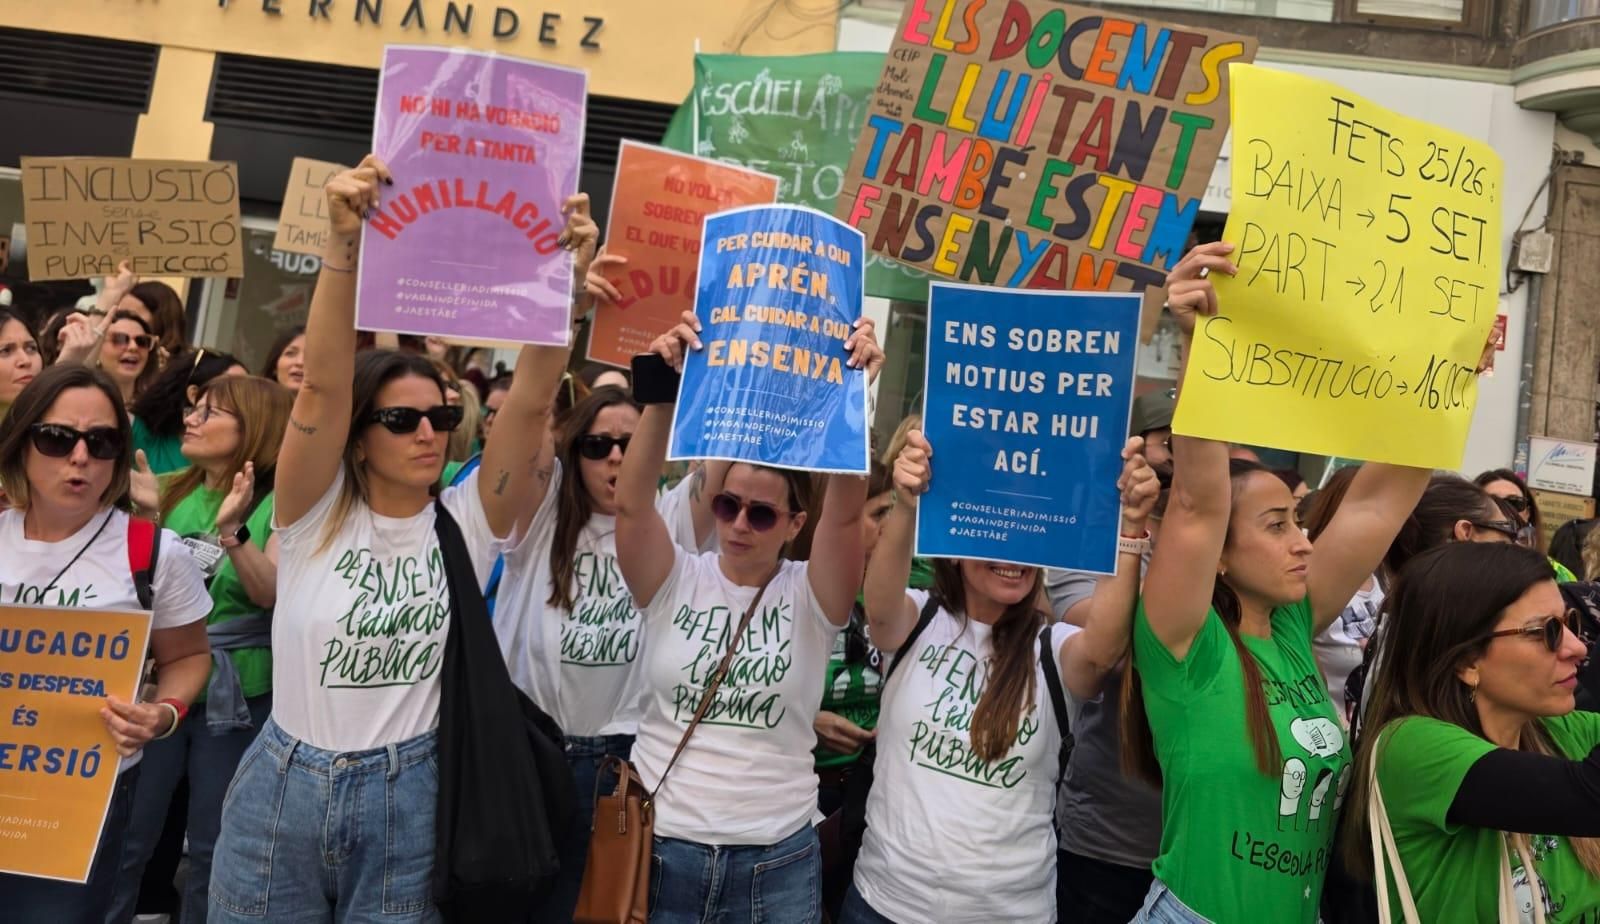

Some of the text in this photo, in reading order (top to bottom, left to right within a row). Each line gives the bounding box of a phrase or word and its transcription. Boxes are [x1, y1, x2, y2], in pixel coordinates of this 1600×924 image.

[219, 0, 604, 48] ERNANDEZ
[903, 0, 1245, 106] ELS DOCENTS
[400, 95, 425, 114] NO
[432, 97, 450, 118] HI
[456, 101, 480, 122] HA
[421, 130, 536, 164] PER A TANTA
[1327, 97, 1405, 177] FETS
[29, 164, 236, 204] INCLUSIÓ
[664, 176, 684, 194] NO
[863, 114, 1037, 221] TAMBÉ
[33, 216, 236, 246] INVERSIÓ
[1027, 158, 1202, 271] ESTEM
[1386, 193, 1412, 243] 5
[626, 226, 645, 244] EL
[648, 231, 680, 251] QUE
[717, 232, 748, 254] PER
[751, 232, 813, 256] CUIDAR
[815, 241, 827, 257] A
[828, 244, 851, 267] QUI
[46, 252, 229, 277] PURA FICCIÓ
[1233, 223, 1485, 323] PART 21 SET
[726, 261, 836, 304] APRÉN,
[710, 304, 850, 341] CAL CUIDAR A QUI
[945, 320, 1121, 354] ENS SOBREN
[707, 340, 843, 385] ENSENYA
[946, 362, 1113, 397] MOTIUS PER
[1414, 354, 1448, 409] 16
[952, 404, 1099, 438] ESTAR HUI
[993, 448, 1048, 477] ACÍ.
[0, 628, 130, 661] UCACIÓ
[12, 704, 39, 727] ÉS
[0, 743, 102, 778] ERSIÓ
[0, 816, 60, 830] IADIMISSIÓ
[1231, 830, 1312, 877] L'ESCOLA
